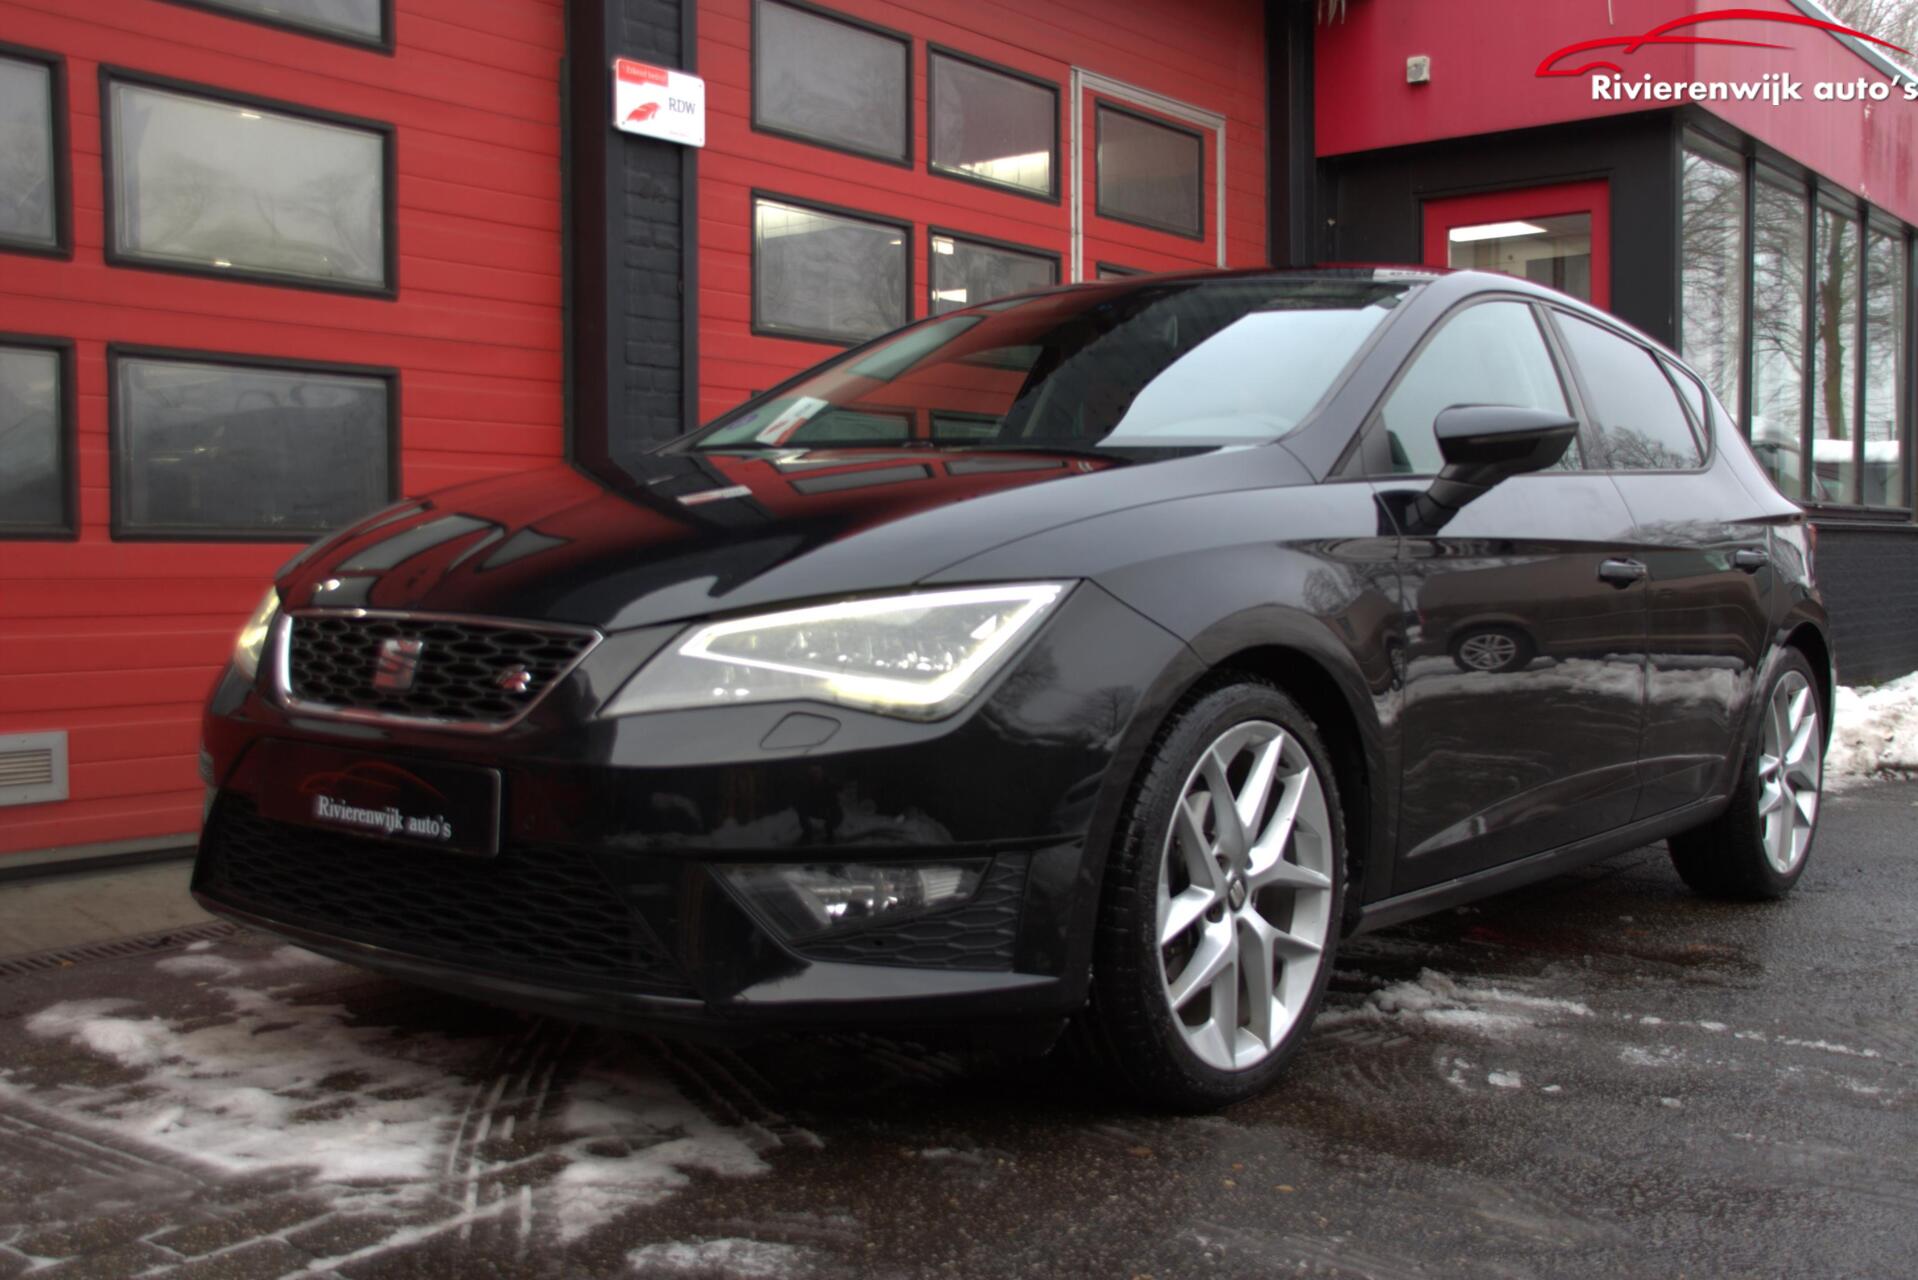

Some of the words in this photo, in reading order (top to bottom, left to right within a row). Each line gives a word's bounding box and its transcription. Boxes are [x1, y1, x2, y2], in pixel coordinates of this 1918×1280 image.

[668, 97, 695, 114] RDW
[317, 795, 404, 832] Rivierenwijk
[409, 815, 452, 839] auto's
